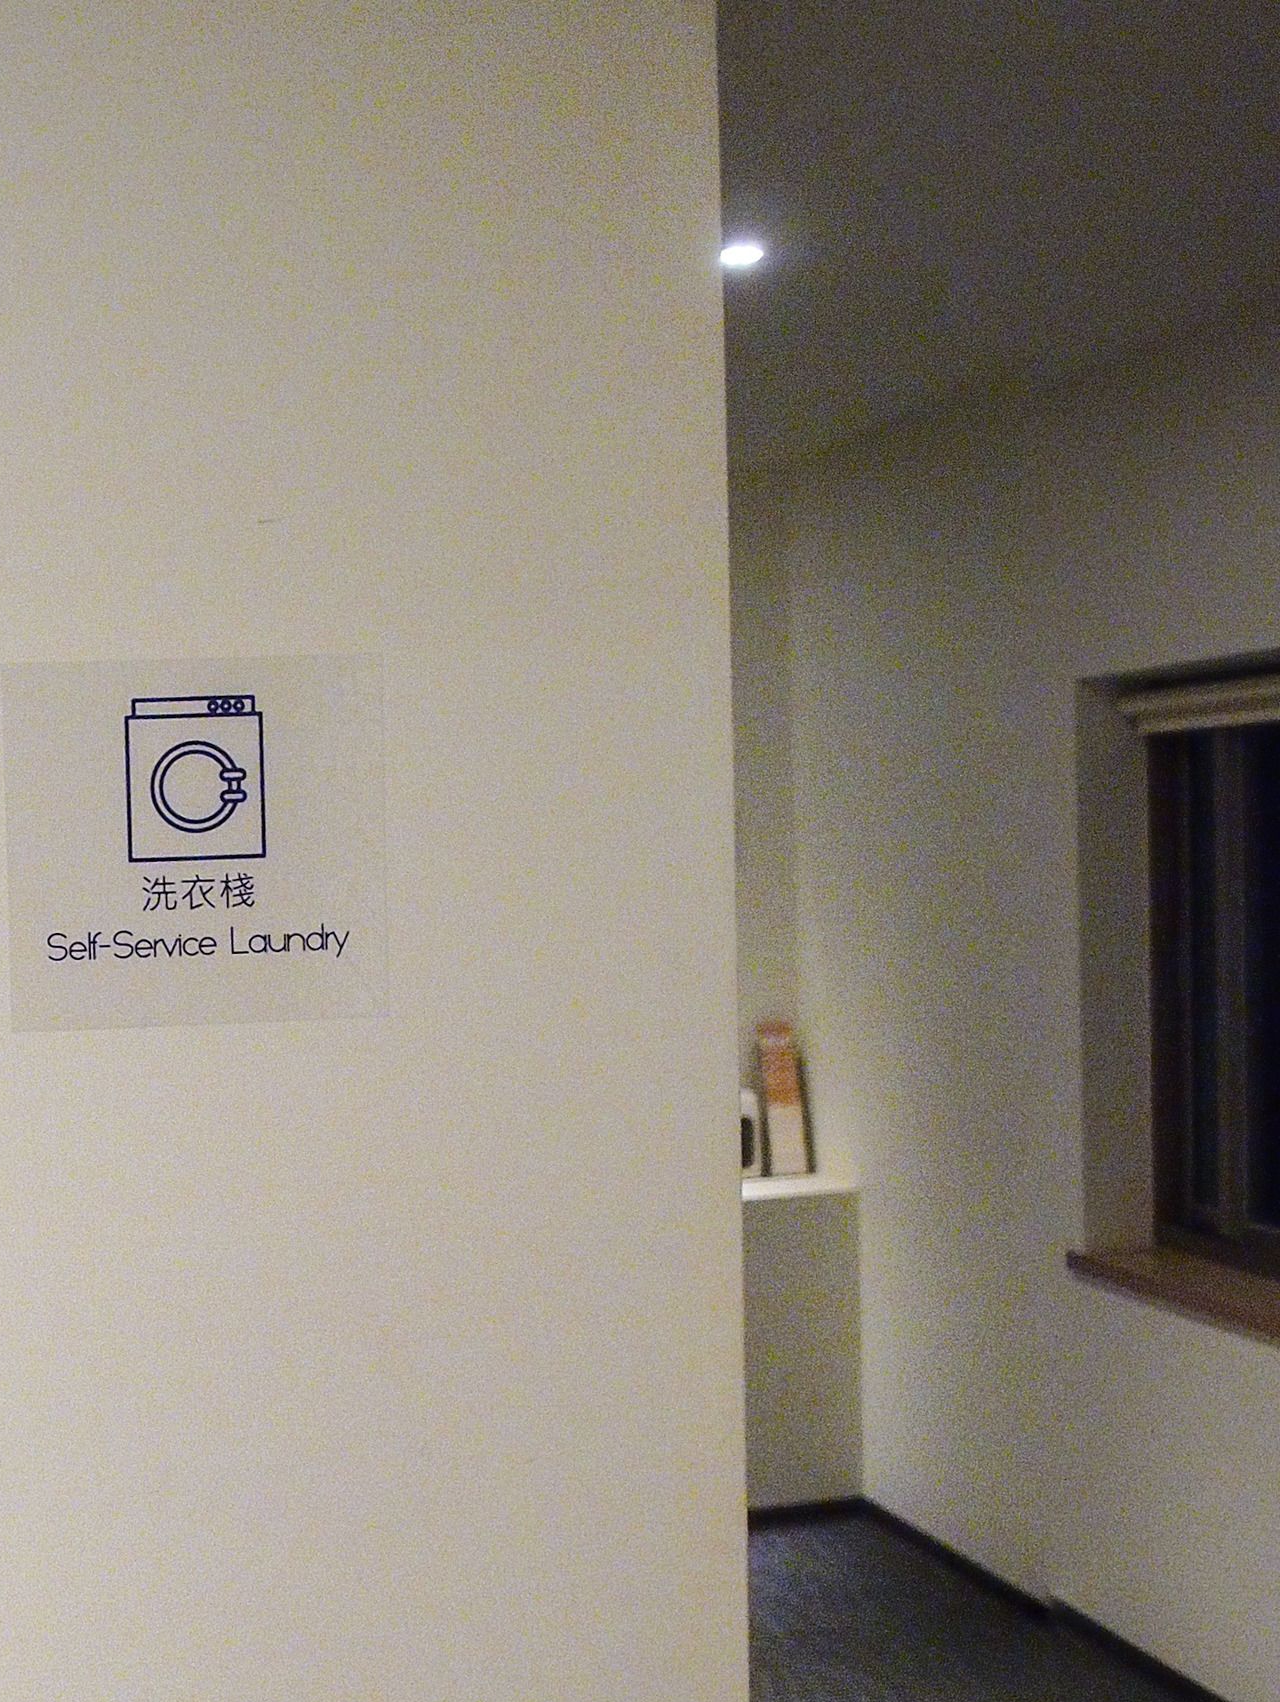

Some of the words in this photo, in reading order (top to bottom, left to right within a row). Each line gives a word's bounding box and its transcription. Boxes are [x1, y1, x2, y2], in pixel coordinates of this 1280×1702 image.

[142, 872, 255, 912] 洗衣棧
[46, 929, 217, 962] Self-Service
[230, 923, 350, 958] Laundry
